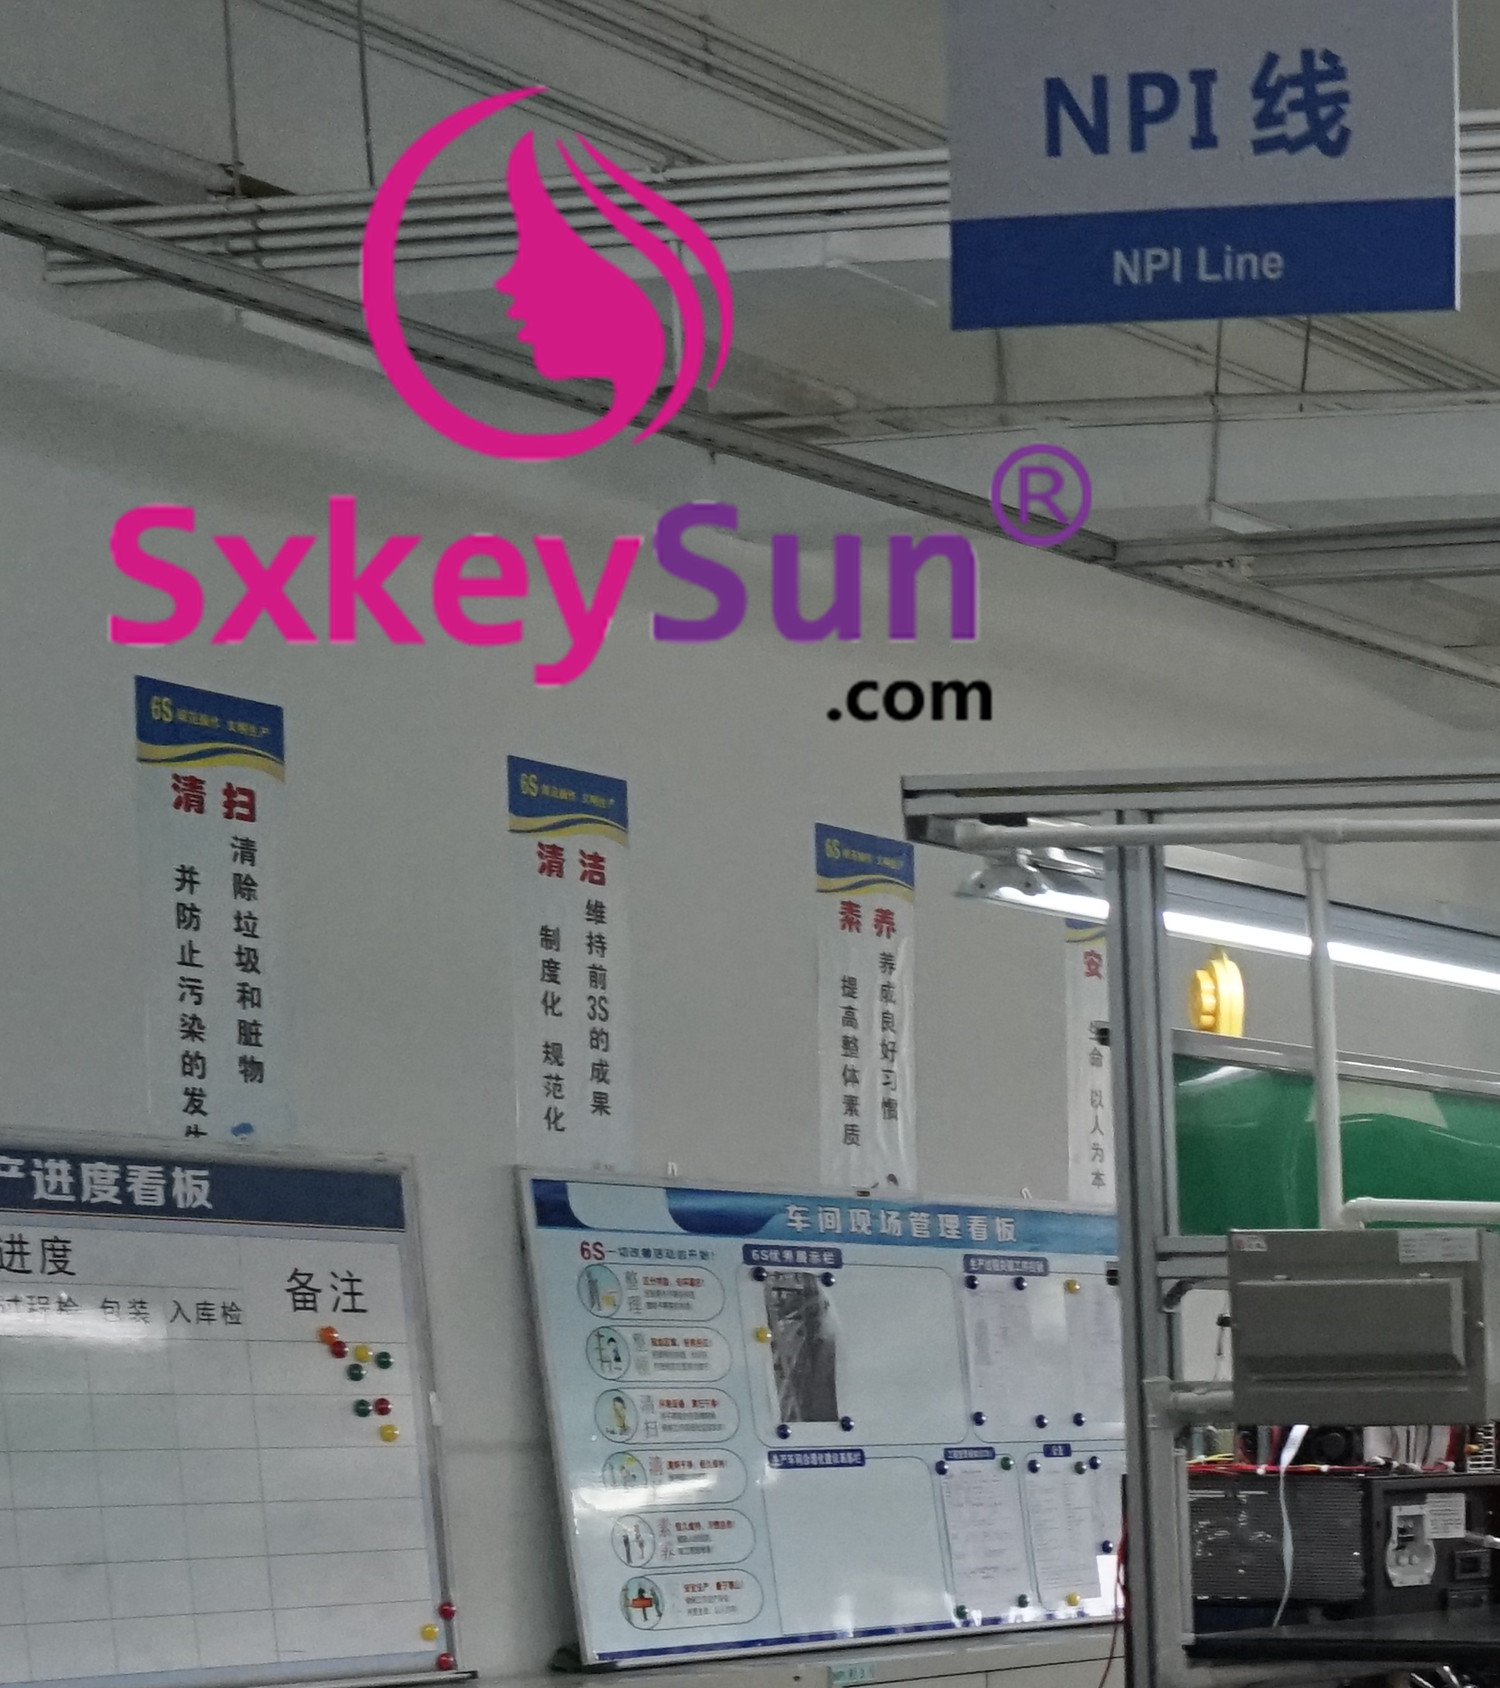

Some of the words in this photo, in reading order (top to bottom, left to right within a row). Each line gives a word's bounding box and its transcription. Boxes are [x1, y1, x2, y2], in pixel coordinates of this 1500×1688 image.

[1041, 68, 1219, 158] NPI
[1250, 48, 1354, 159] 线
[1111, 245, 1182, 287] NPI
[1196, 241, 1285, 283] Line
[171, 772, 256, 823] 清扫
[536, 841, 607, 887] 清洁
[229, 836, 265, 1084] 清除垃圾和脏物
[584, 899, 612, 1117] 维持前3S的成果
[785, 1203, 1018, 1244] 车间现场管理看板
[170, 1300, 243, 1326] 入库检
[285, 1267, 368, 1315] 备注
